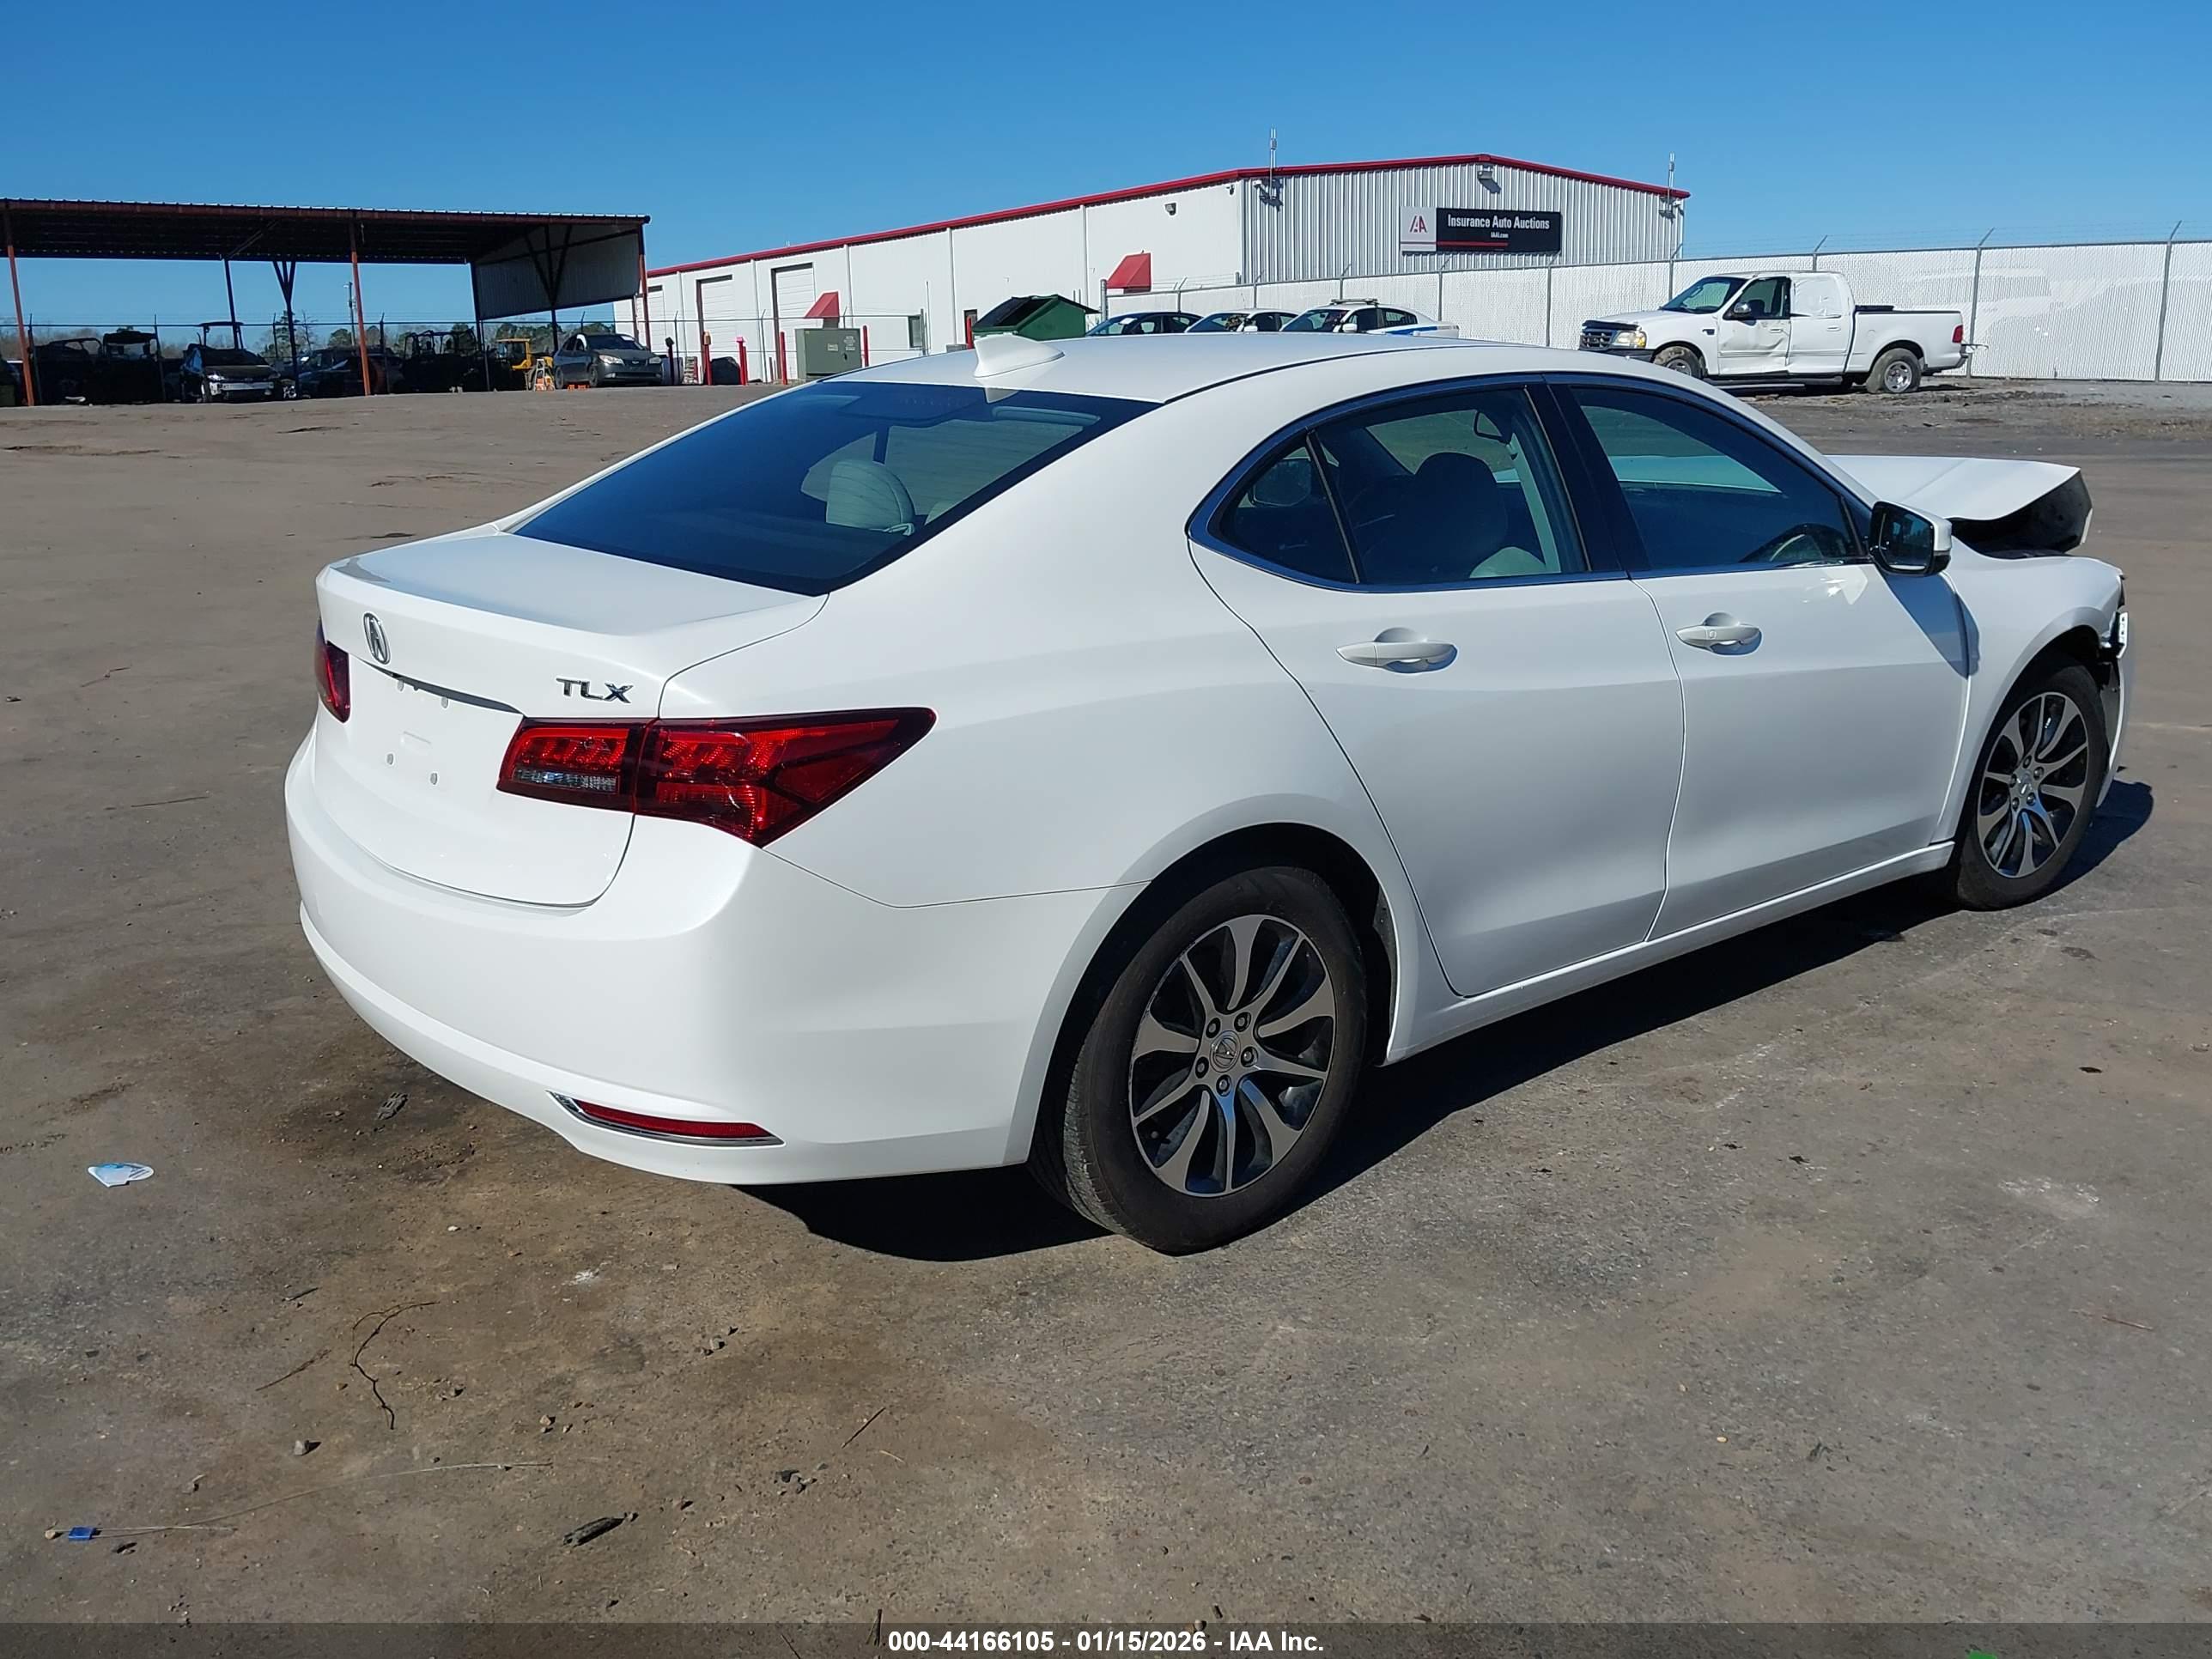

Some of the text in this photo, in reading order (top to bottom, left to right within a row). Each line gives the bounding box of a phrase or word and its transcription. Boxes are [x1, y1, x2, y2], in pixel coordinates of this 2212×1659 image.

[1448, 214, 1550, 229] Insurance Auto Auctions
[556, 678, 634, 703] TLX
